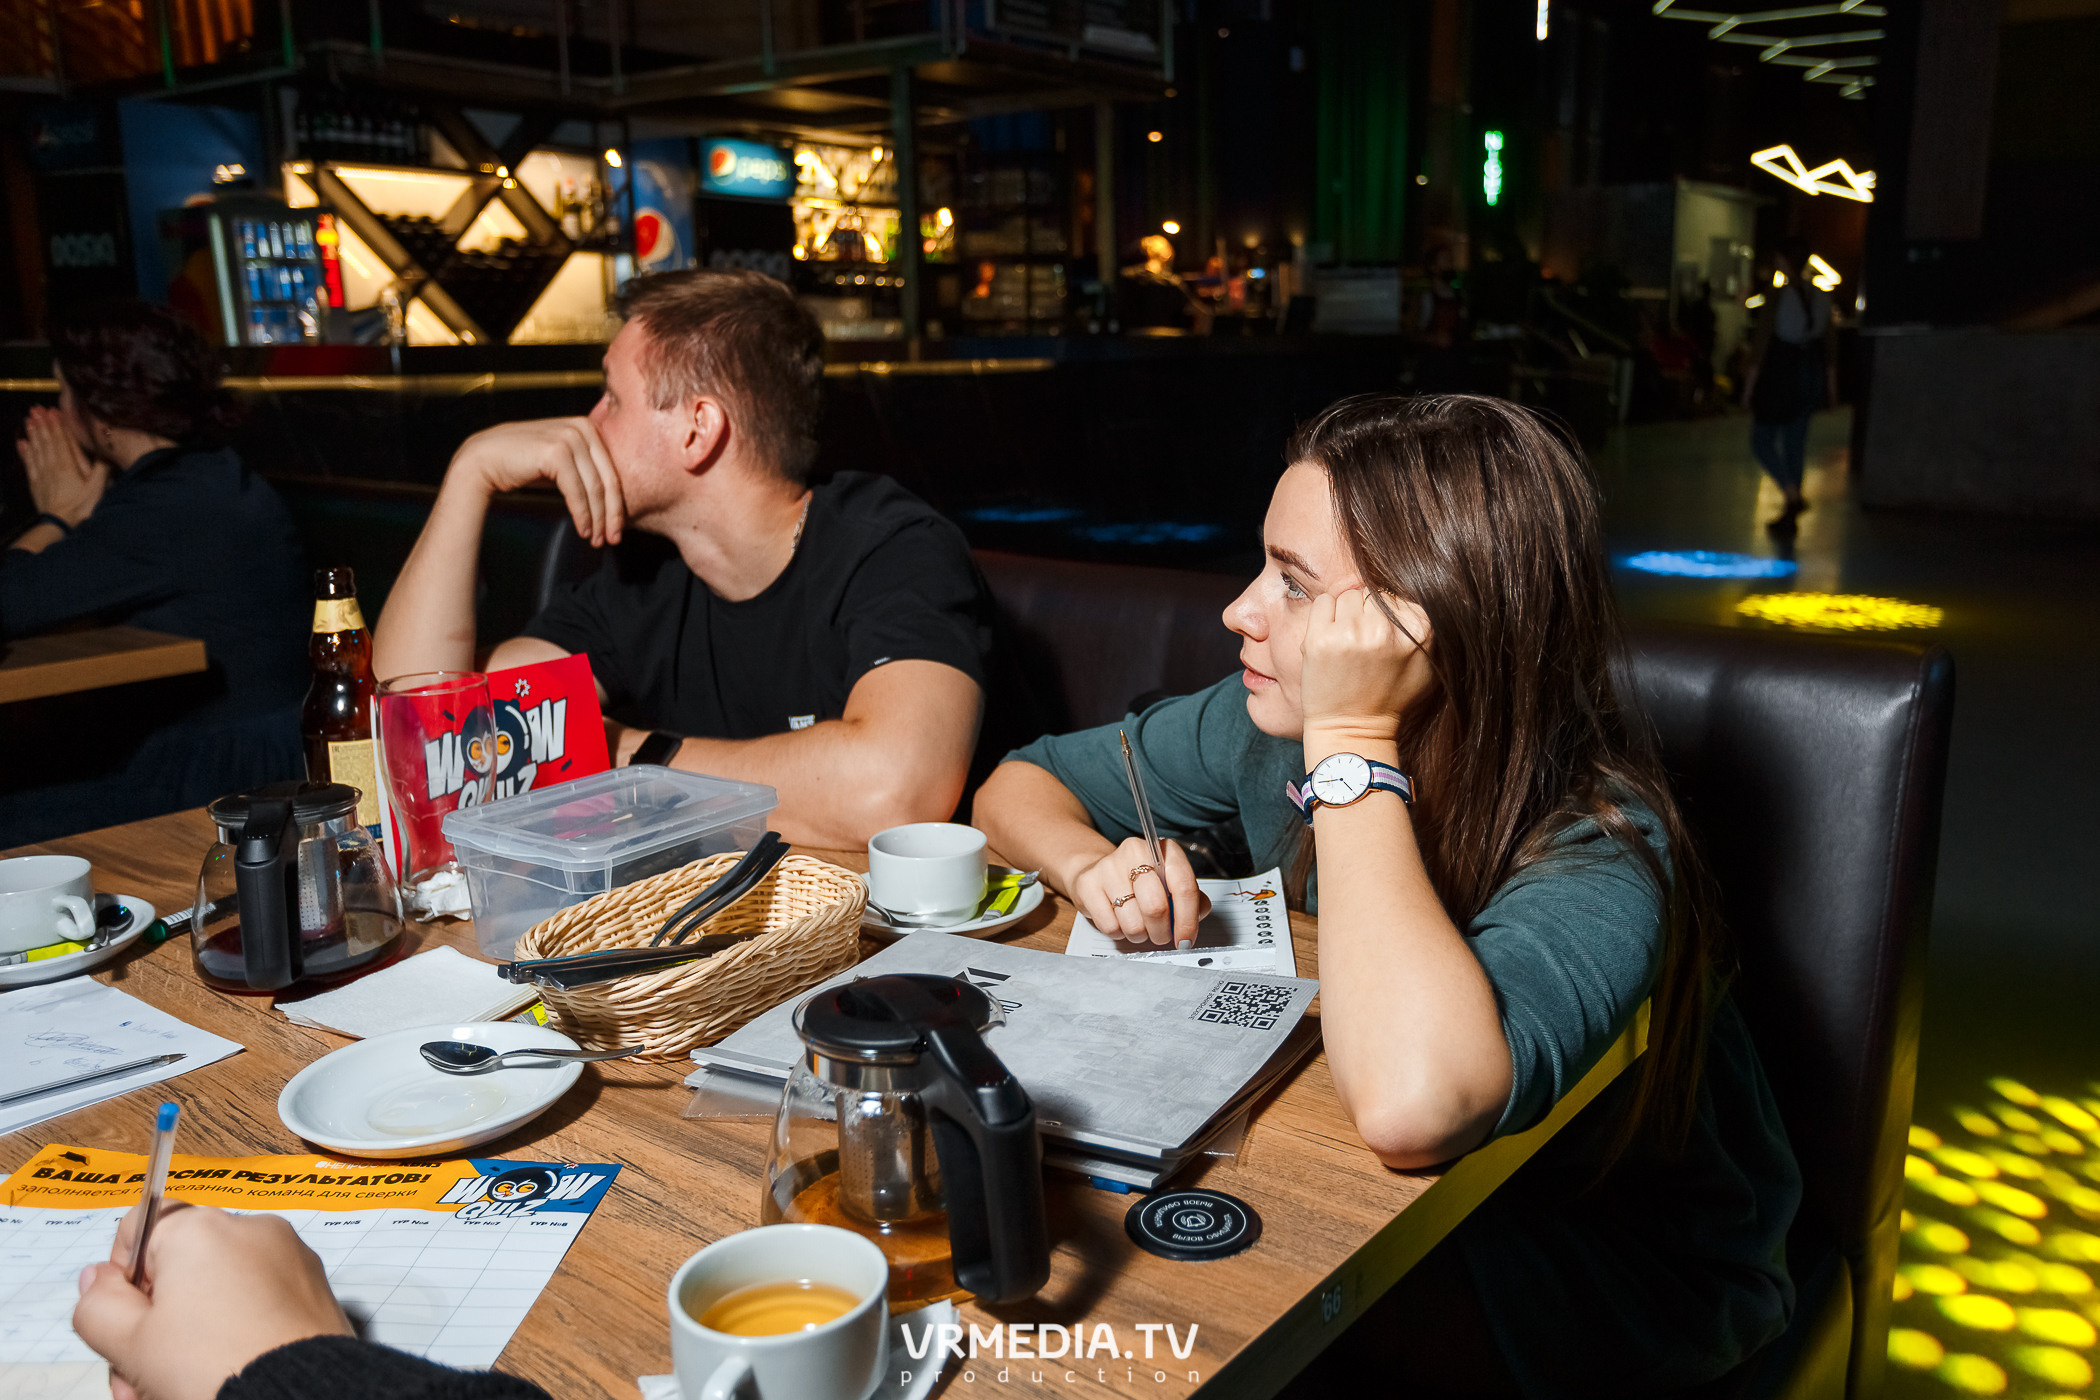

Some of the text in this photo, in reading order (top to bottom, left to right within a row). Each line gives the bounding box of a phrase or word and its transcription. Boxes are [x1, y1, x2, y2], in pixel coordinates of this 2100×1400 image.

[32, 1167, 433, 1186] ВАША ВРСИЯ РЕЗУЛЬТАТОВ!
[17, 1184, 131, 1197] заполняется
[247, 1188, 315, 1198] команд
[316, 1190, 351, 1199] для
[355, 1188, 419, 1199] сверки
[454, 1198, 551, 1220] QUIZ
[1323, 1286, 1341, 1322] 66
